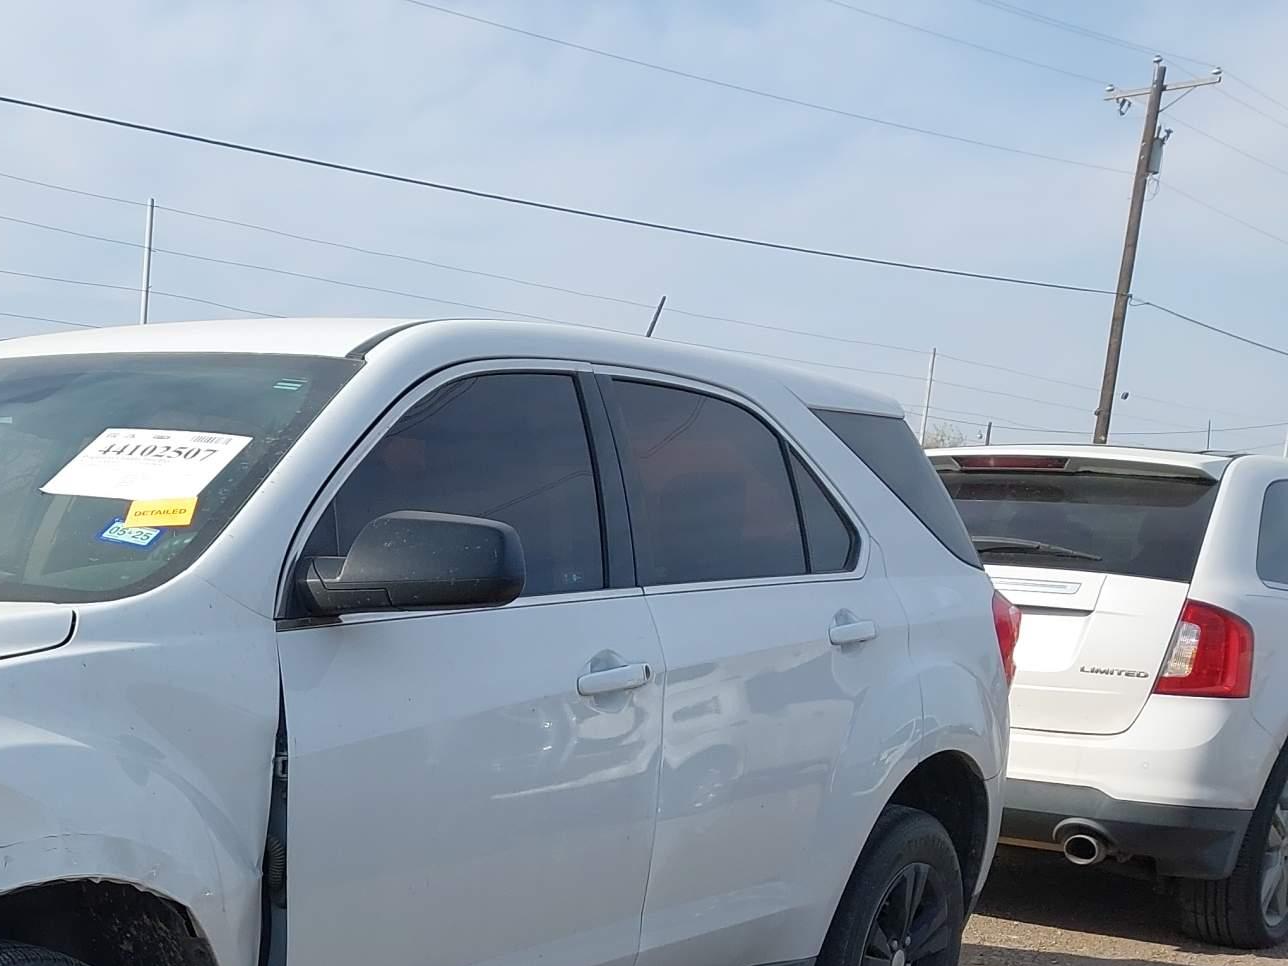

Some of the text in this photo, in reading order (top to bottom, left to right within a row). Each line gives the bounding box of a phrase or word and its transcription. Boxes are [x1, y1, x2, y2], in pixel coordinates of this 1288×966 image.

[98, 443, 218, 461] 44102507
[134, 508, 187, 517] DETAILED
[1079, 665, 1149, 678] LIMITED
